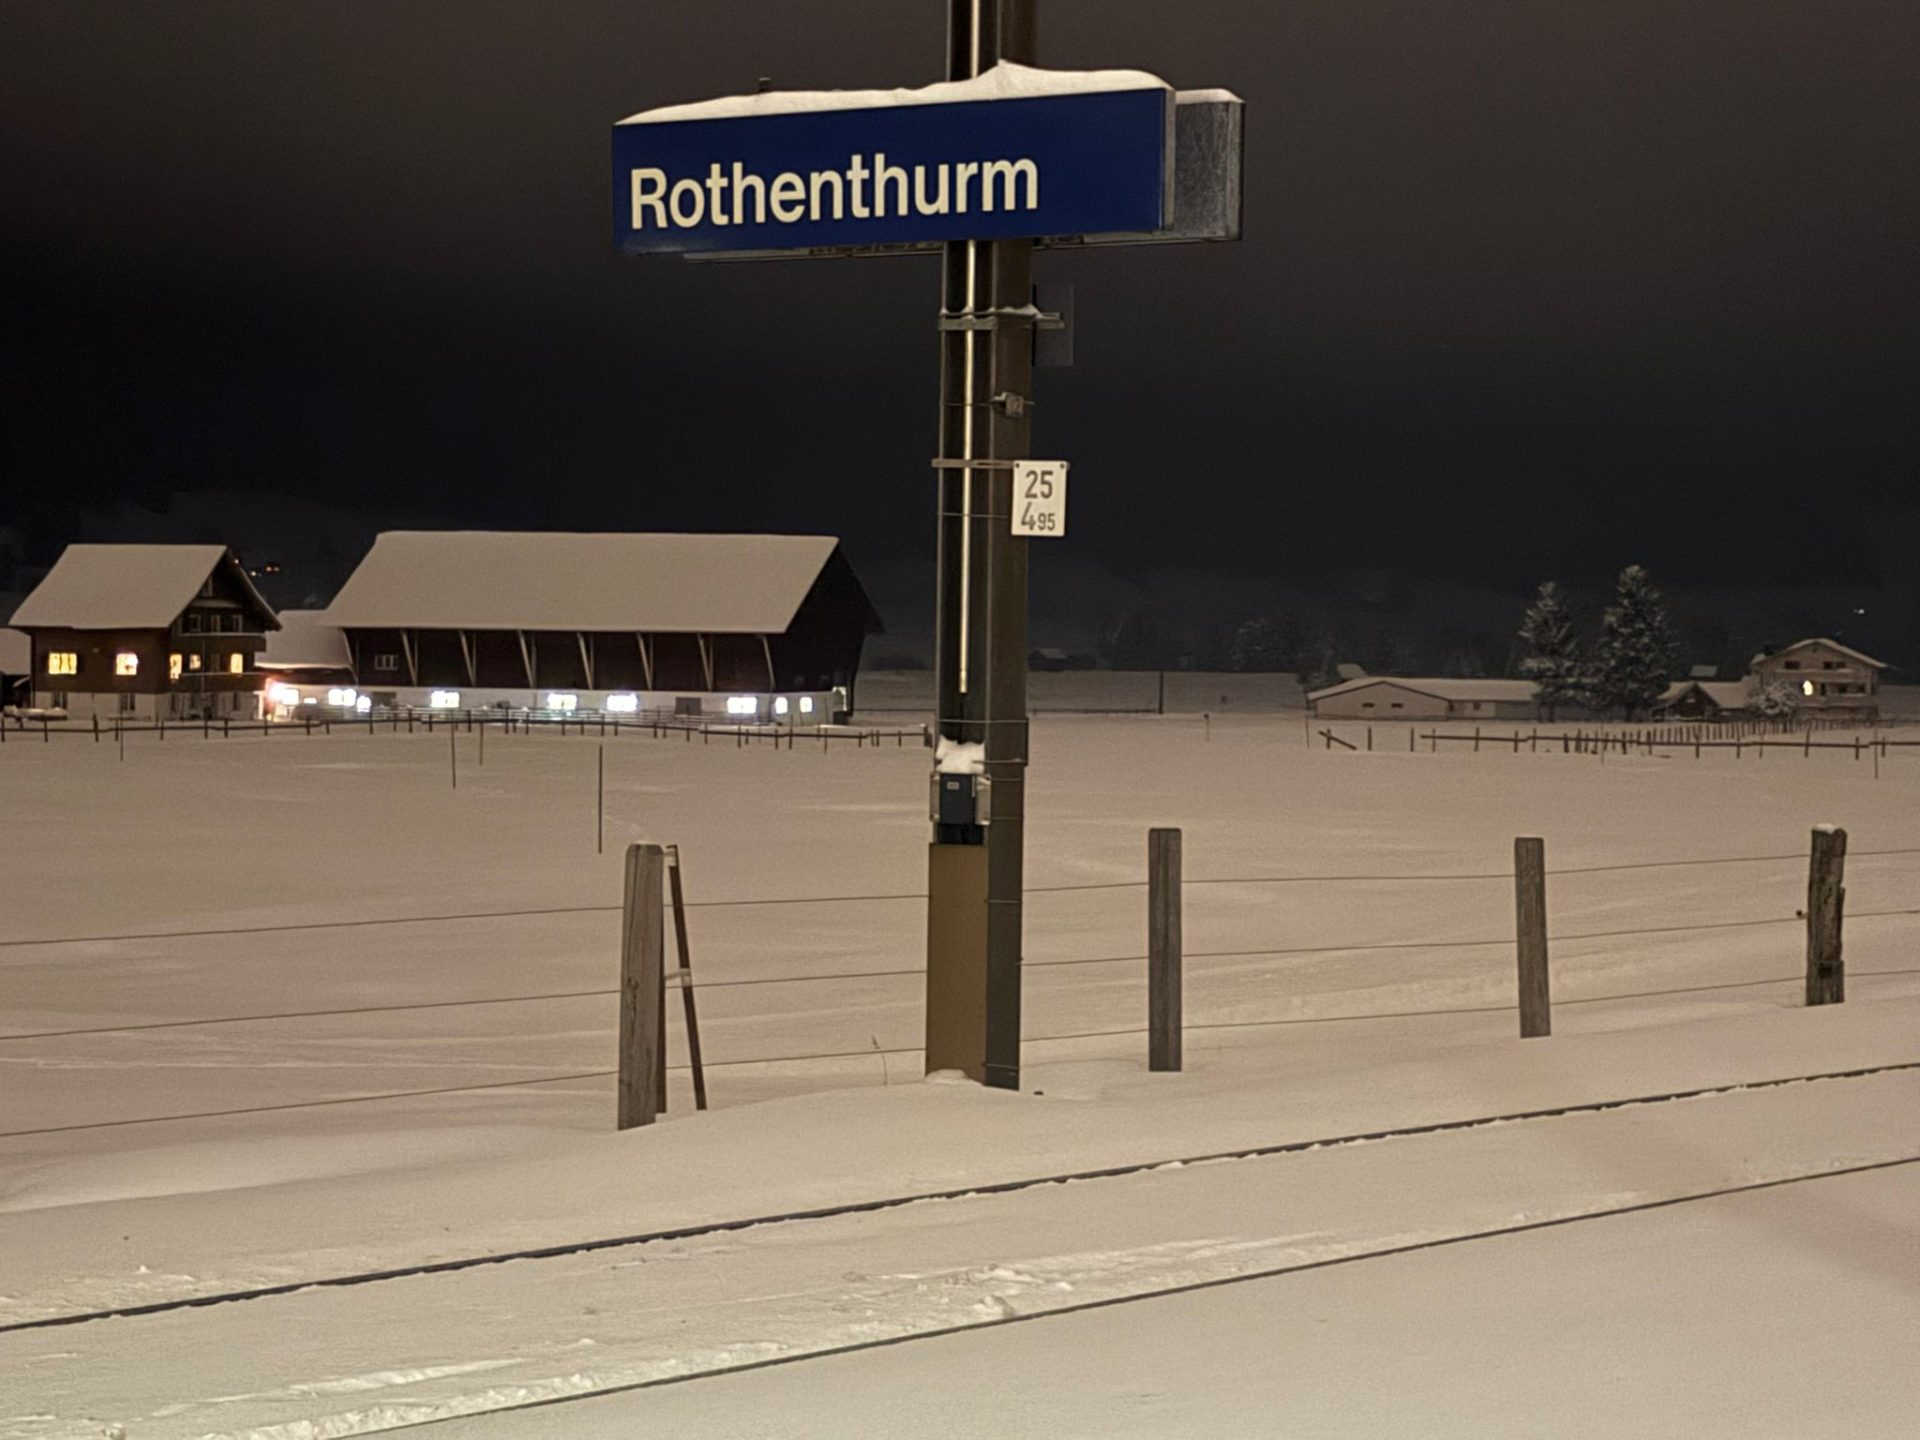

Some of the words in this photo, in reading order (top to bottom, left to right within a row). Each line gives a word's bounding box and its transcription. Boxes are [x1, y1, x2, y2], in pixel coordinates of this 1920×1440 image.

[631, 152, 1039, 230] Rothenthurm
[1025, 470, 1053, 498] 25
[1021, 501, 1056, 531] 495
